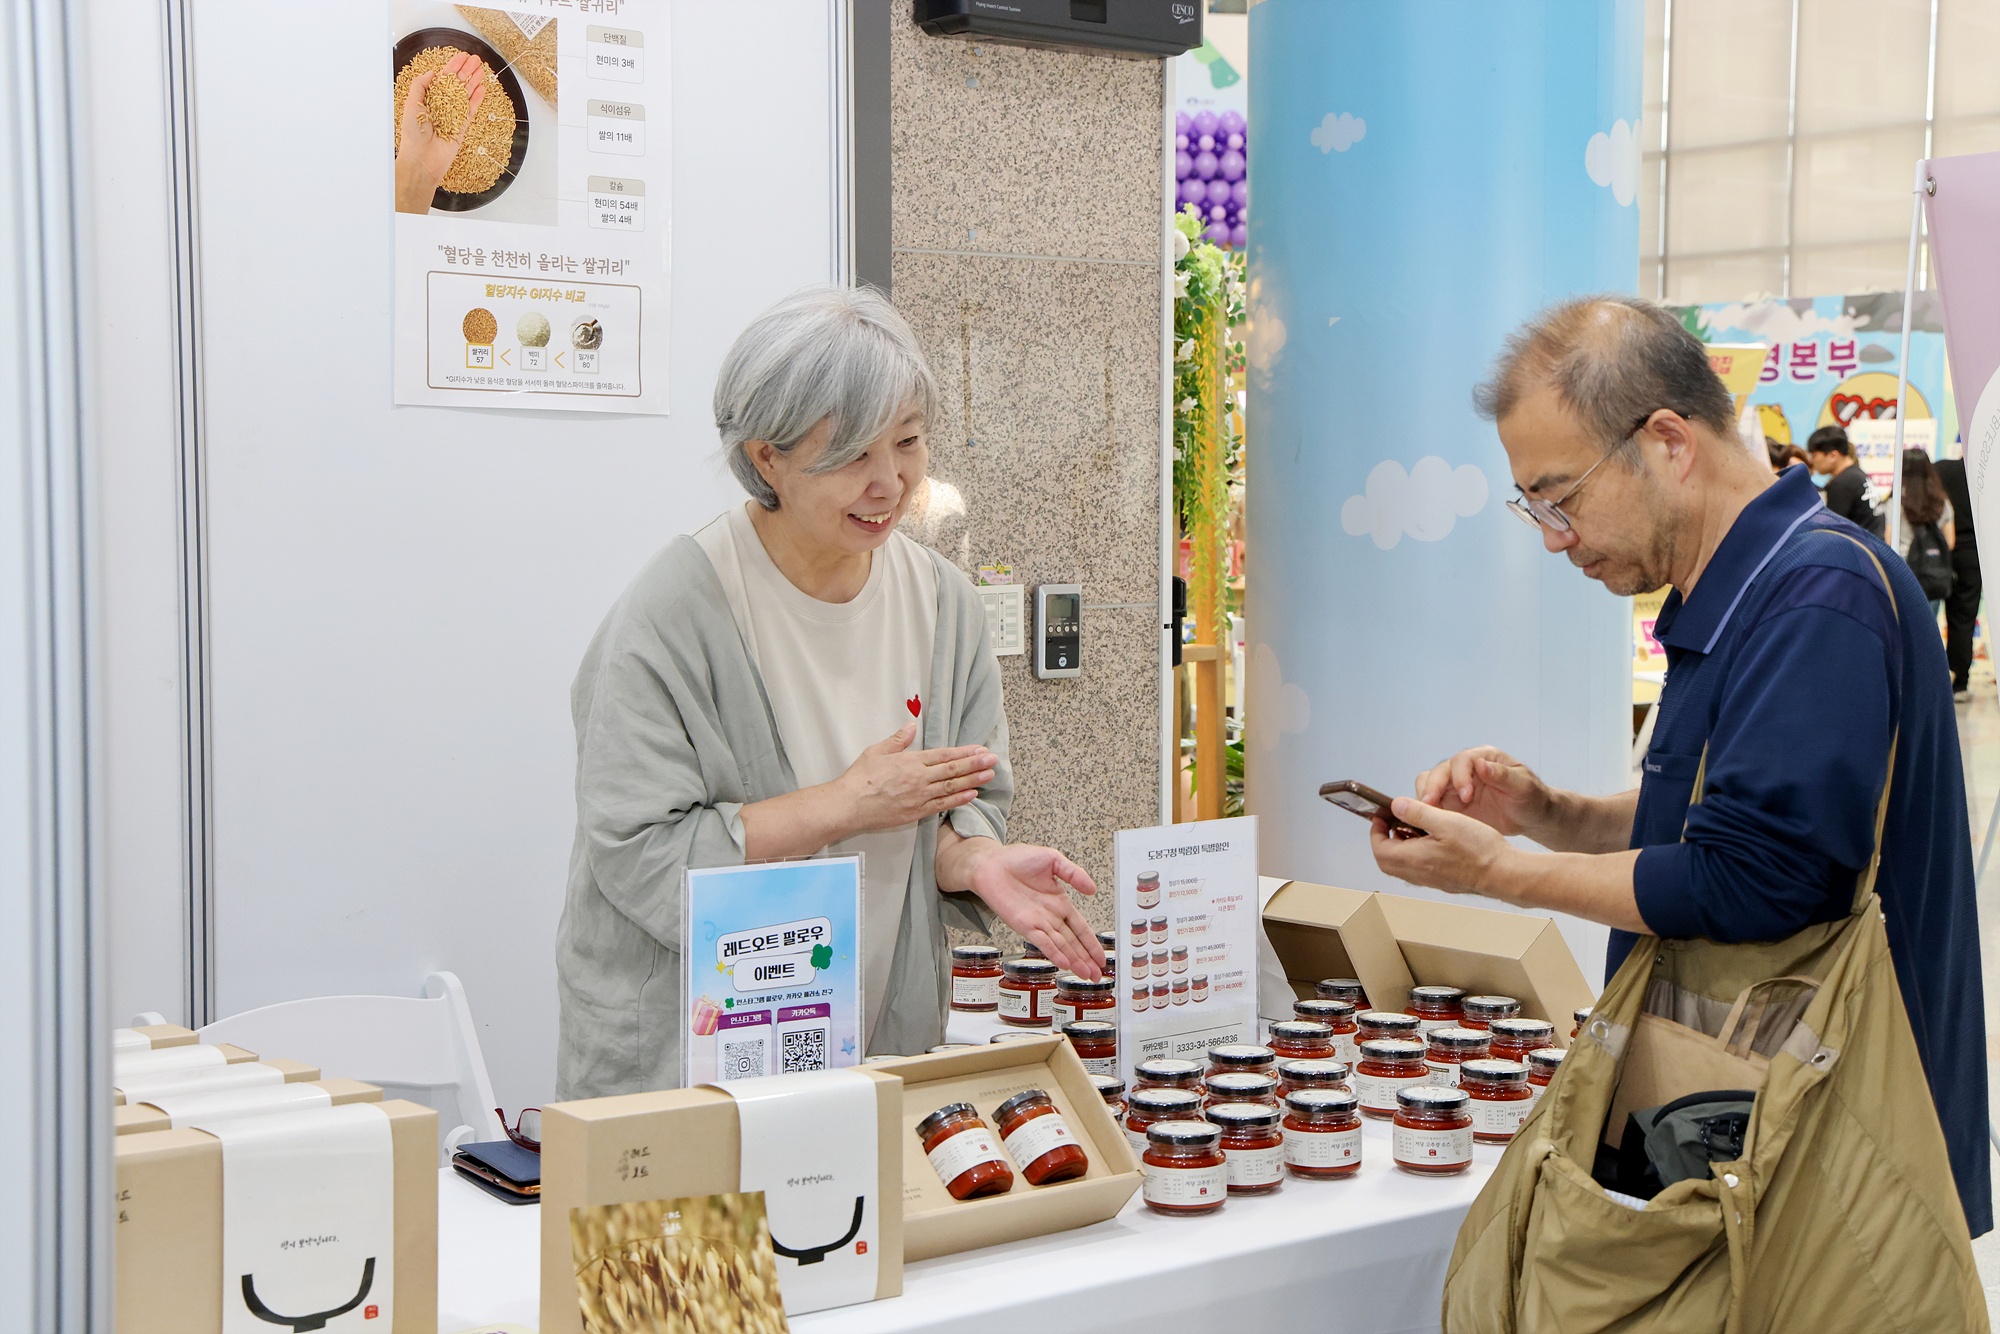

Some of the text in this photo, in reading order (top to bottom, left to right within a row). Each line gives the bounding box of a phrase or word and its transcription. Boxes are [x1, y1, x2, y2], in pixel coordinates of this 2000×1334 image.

[1171, 3, 1194, 17] CESCO
[603, 32, 627, 46] 단백질
[596, 54, 634, 69] 현미의 3배
[600, 104, 632, 116] 식이섬유
[598, 130, 632, 142] 쌀의 11배
[609, 181, 624, 191] 칼슘
[594, 198, 638, 211] 현미의 54배
[601, 213, 632, 225] 쌀의 4배
[438, 244, 630, 276] "혈당을 천천히 올리는 쌀귀리"
[485, 283, 586, 303] 혈당지수 GI지수 비교
[472, 348, 488, 356] 쌀귀리
[474, 376, 486, 384] 낮은
[487, 378, 504, 386] 음식은
[524, 379, 542, 387] 서서히
[556, 380, 594, 389] 혈당스파이크를
[1148, 842, 1230, 860] 도봉구청 박람회 특별할인
[1188, 914, 1206, 922] 30,000원
[1188, 925, 1206, 933] 25,000원
[724, 926, 824, 958] 레드오트 팔로우
[1208, 942, 1226, 951] 45,000원
[754, 962, 795, 981] 이벤트
[736, 996, 764, 1006] 인스타그램
[786, 992, 803, 1000] 카카오
[804, 990, 820, 998] 플러스
[822, 988, 833, 996] 친구
[791, 1007, 816, 1017] 카카오톡
[730, 1014, 762, 1024] 인스타그램
[1142, 1034, 1238, 1053] 카카오뱅크 3333-34-5664836
[116, 1190, 131, 1202] 드
